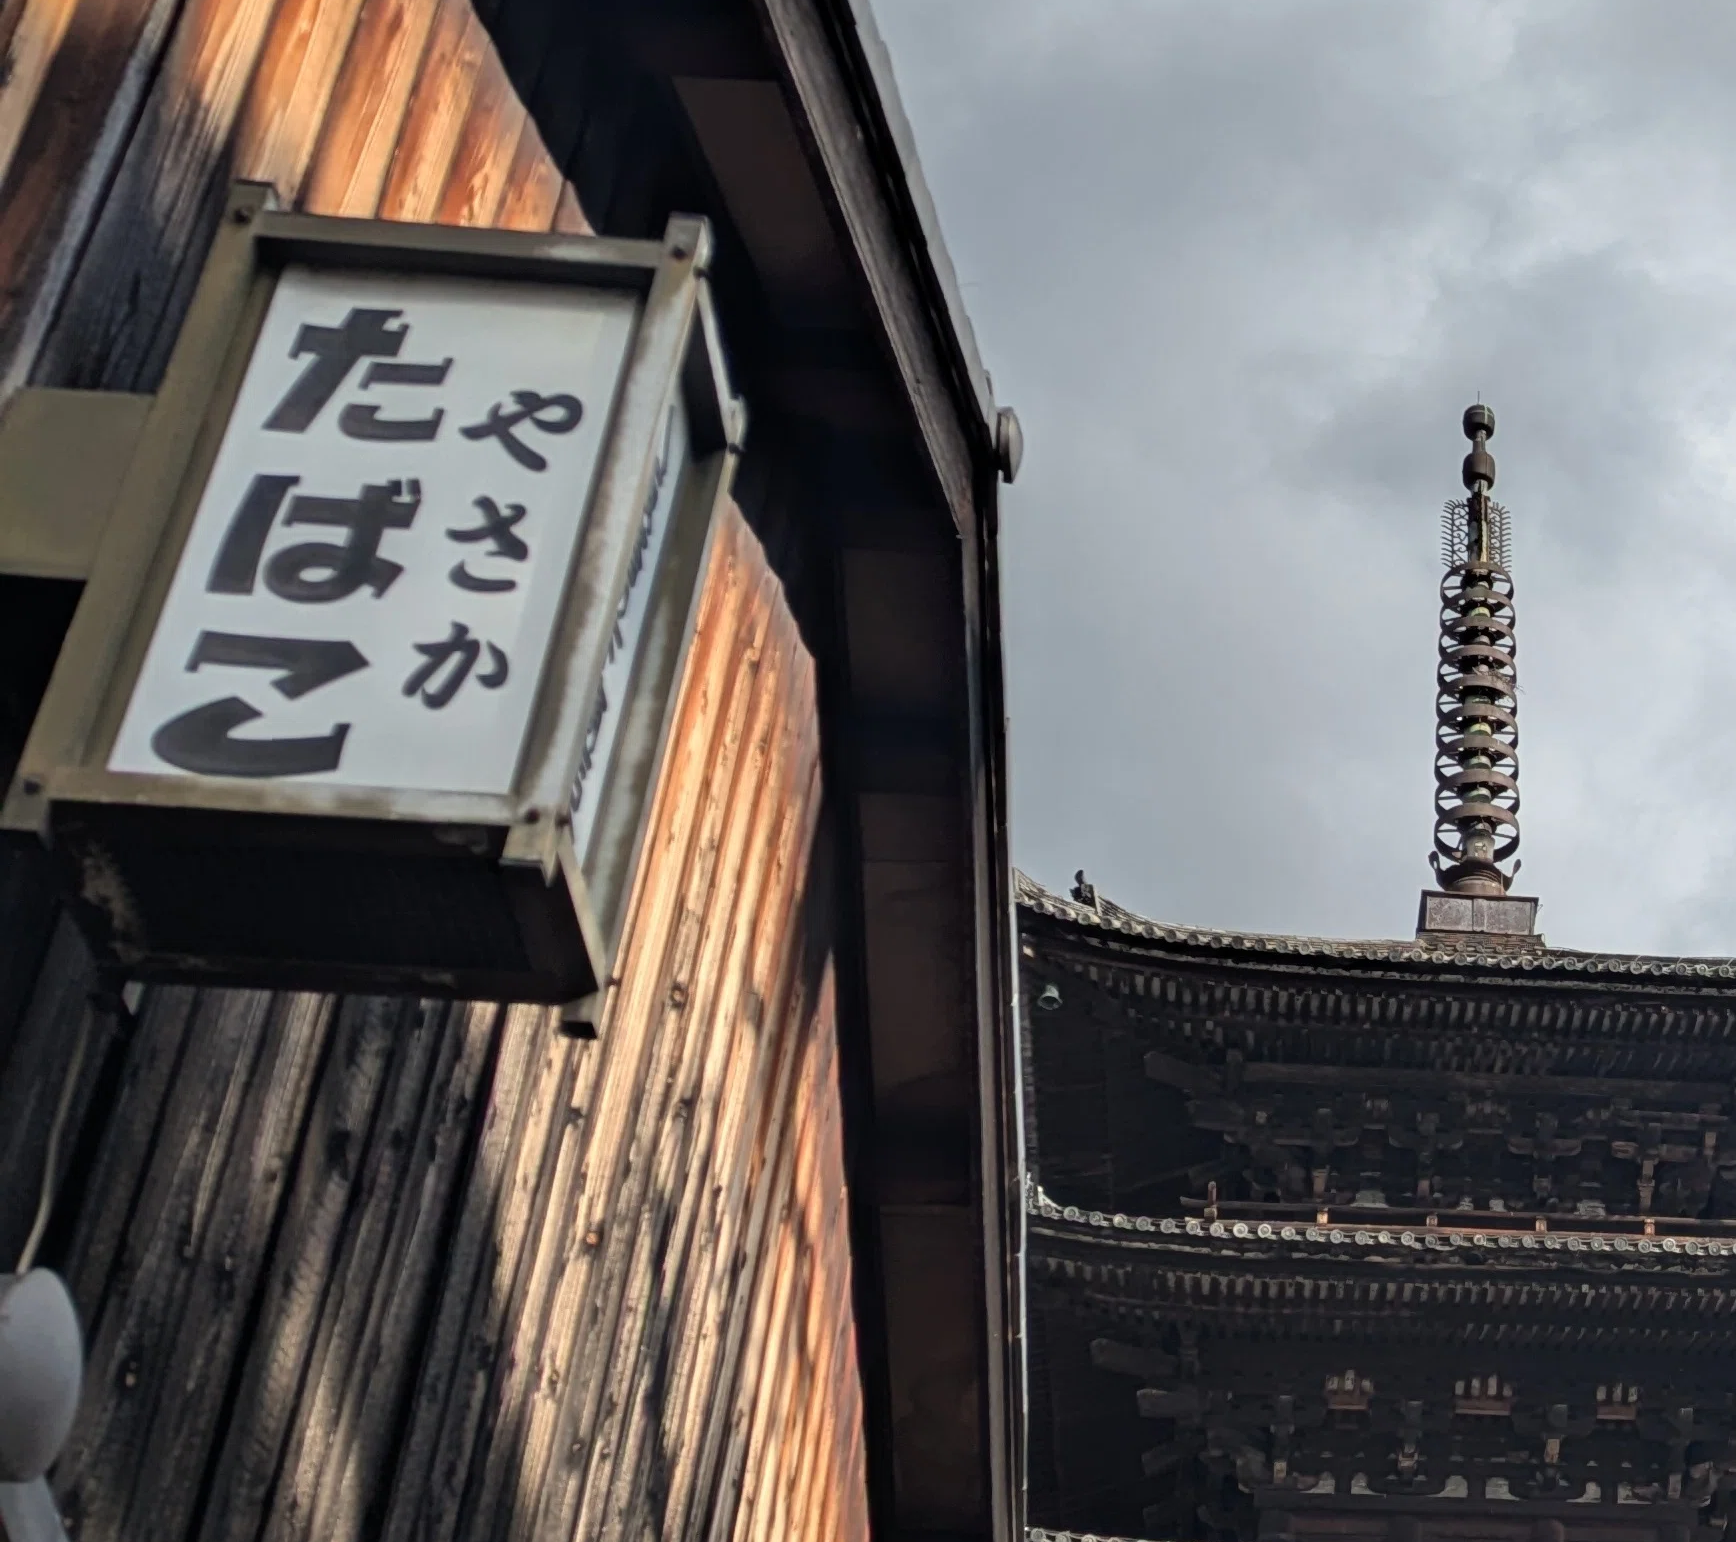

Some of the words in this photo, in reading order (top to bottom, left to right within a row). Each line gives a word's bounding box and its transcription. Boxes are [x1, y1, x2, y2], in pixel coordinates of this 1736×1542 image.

[150, 307, 455, 779] たばこ
[401, 389, 584, 710] やさか
